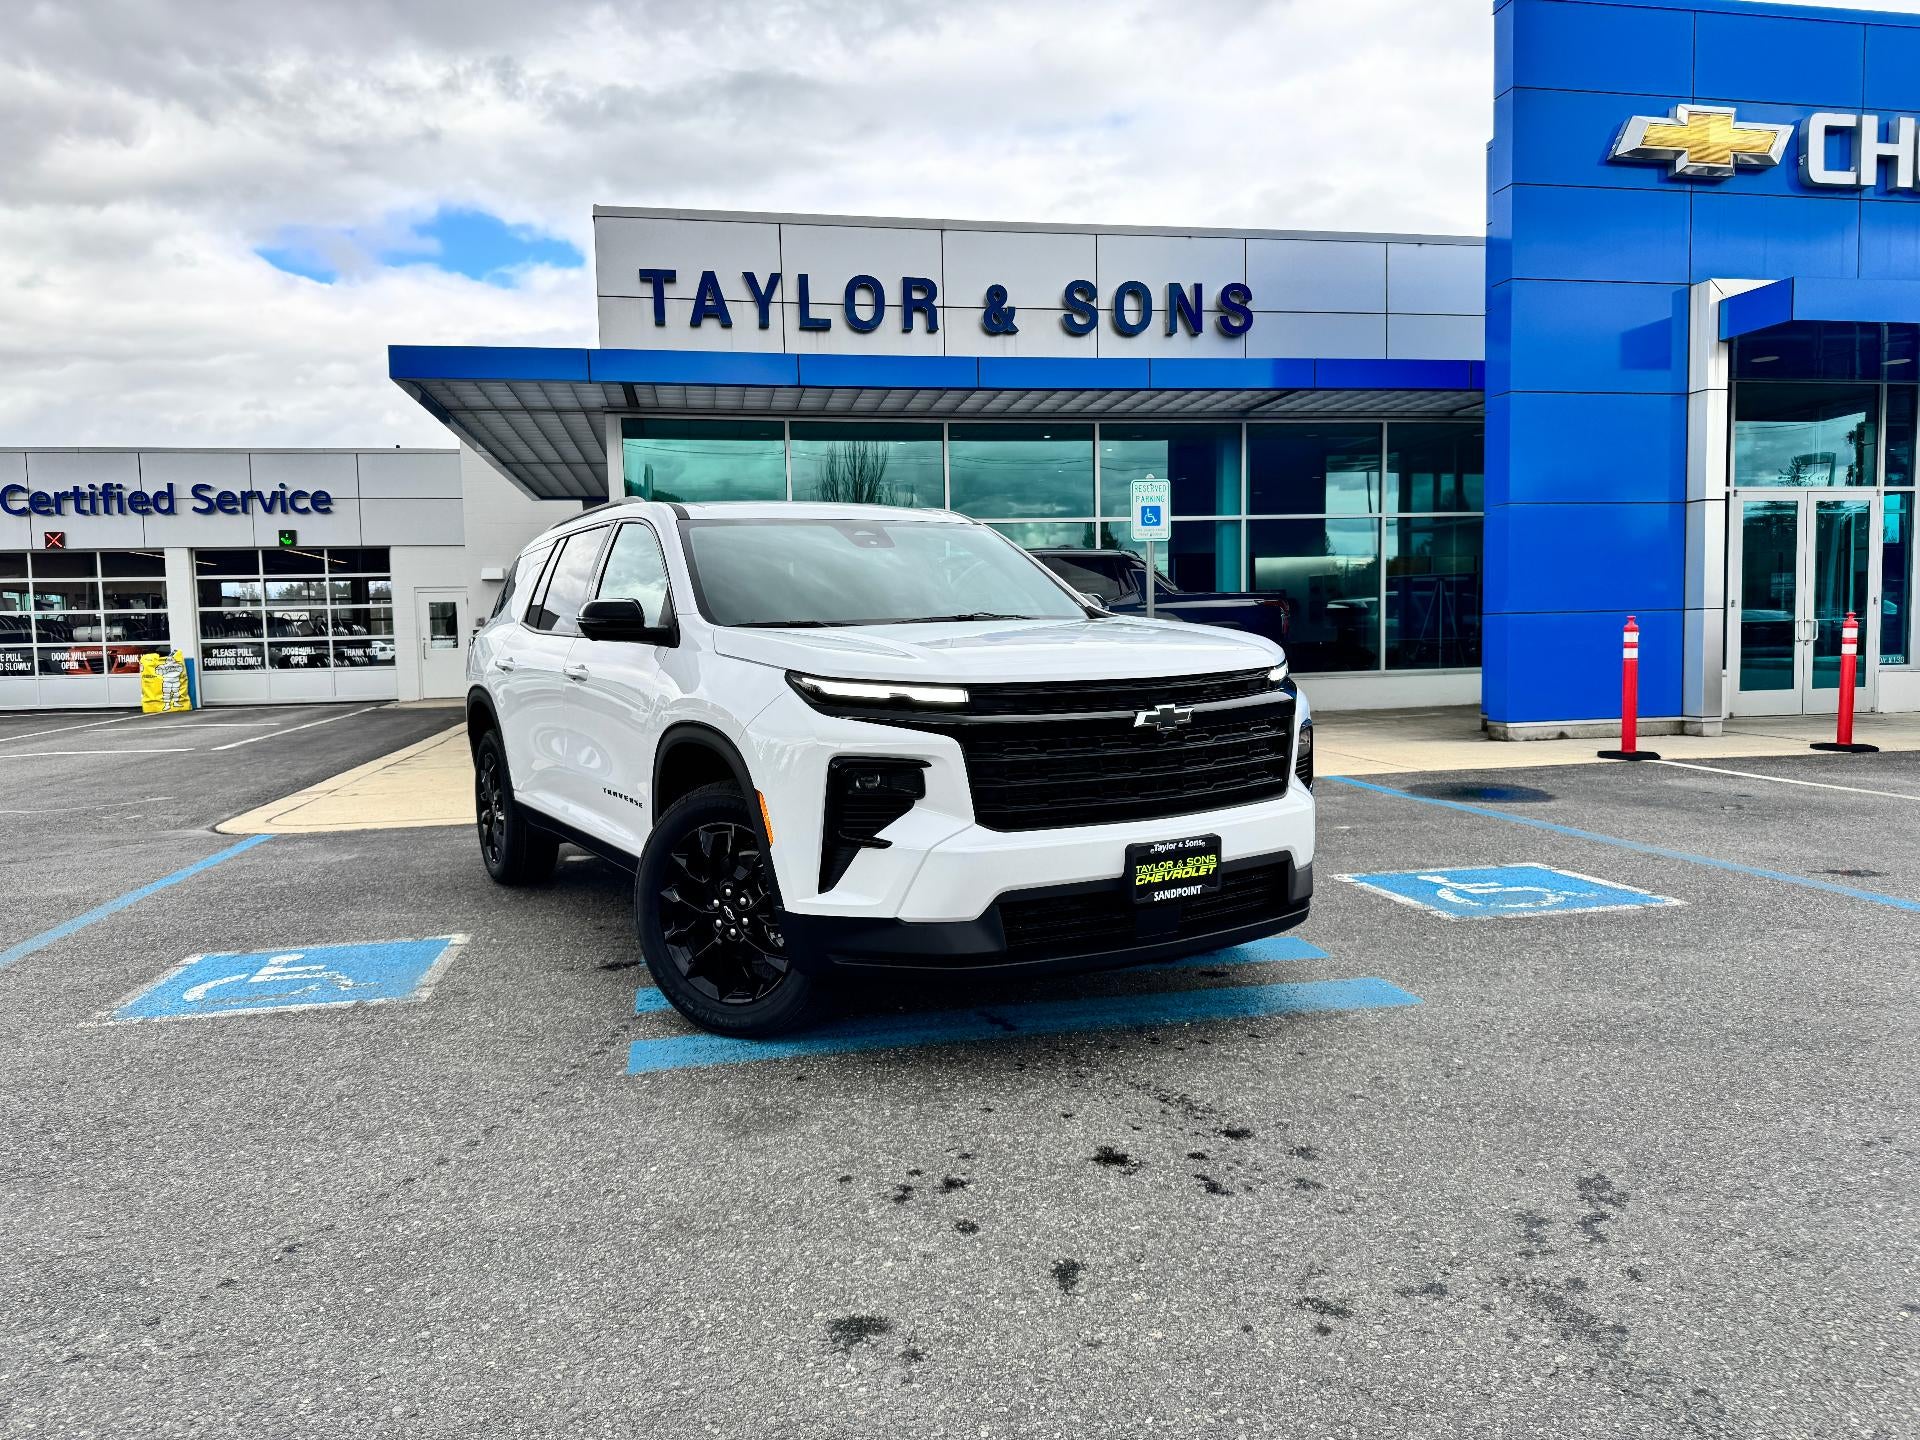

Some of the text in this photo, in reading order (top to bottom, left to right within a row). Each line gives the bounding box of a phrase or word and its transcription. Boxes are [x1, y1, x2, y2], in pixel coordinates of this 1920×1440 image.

[1799, 112, 1920, 191] CH
[639, 268, 1254, 337] TAYLOR & SONS
[1134, 484, 1167, 493] RESERVED
[0, 483, 333, 516] Certified Service
[1135, 495, 1165, 503] PARKING
[5, 653, 23, 662] PULL
[51, 651, 88, 661] DOOR WILL
[211, 647, 254, 658] PLEASE PULL
[343, 647, 379, 657] THANK YOU
[117, 654, 140, 663] THANK
[203, 656, 262, 667] FORWARD SLOWLY
[289, 655, 308, 664] OPEN
[5, 661, 32, 671] SLOWLY
[61, 661, 79, 670] OPEN
[602, 787, 643, 809] TRAVERSE
[1153, 842, 1177, 853] Taylor
[1185, 839, 1202, 848] Sons
[1136, 854, 1217, 874] TAYLOR & SONS
[1135, 865, 1217, 886] CHEVROLET
[1153, 885, 1203, 902] SANDPOINT
